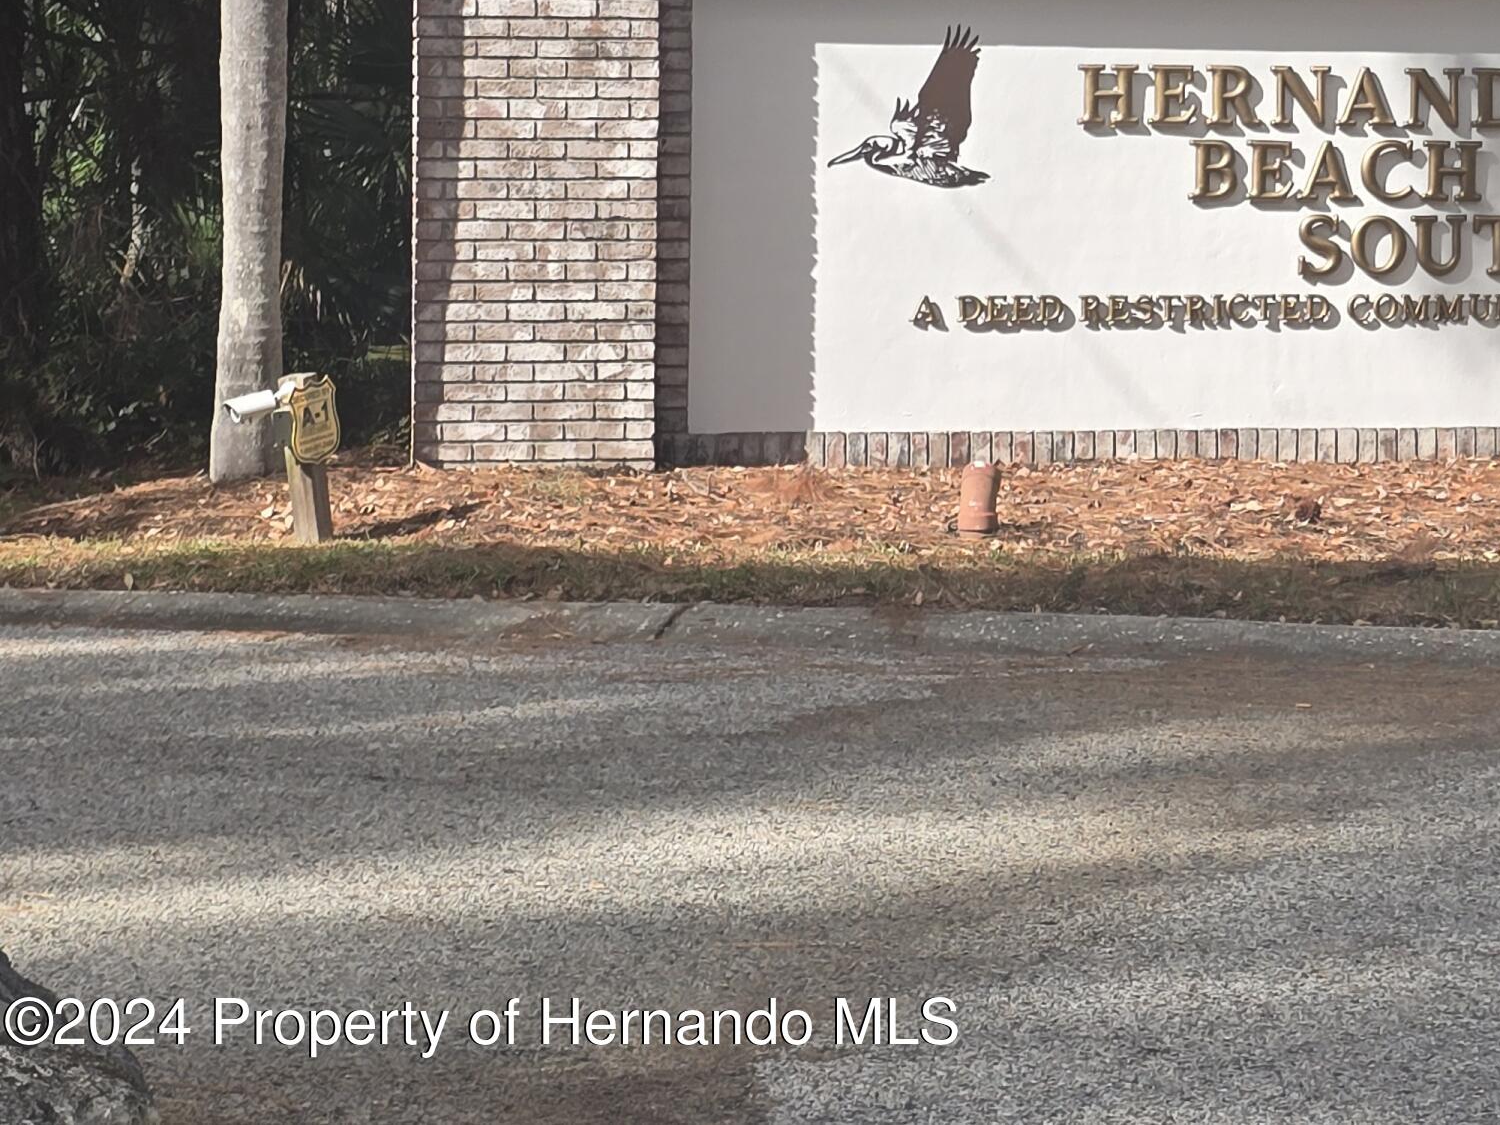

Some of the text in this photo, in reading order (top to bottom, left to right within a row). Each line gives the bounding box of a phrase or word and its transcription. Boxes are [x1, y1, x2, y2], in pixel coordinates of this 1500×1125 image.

[1187, 139, 1484, 202] BEACH
[910, 294, 938, 326] A
[957, 295, 1065, 325] DEED
[1078, 293, 1332, 325] RESTRICTED
